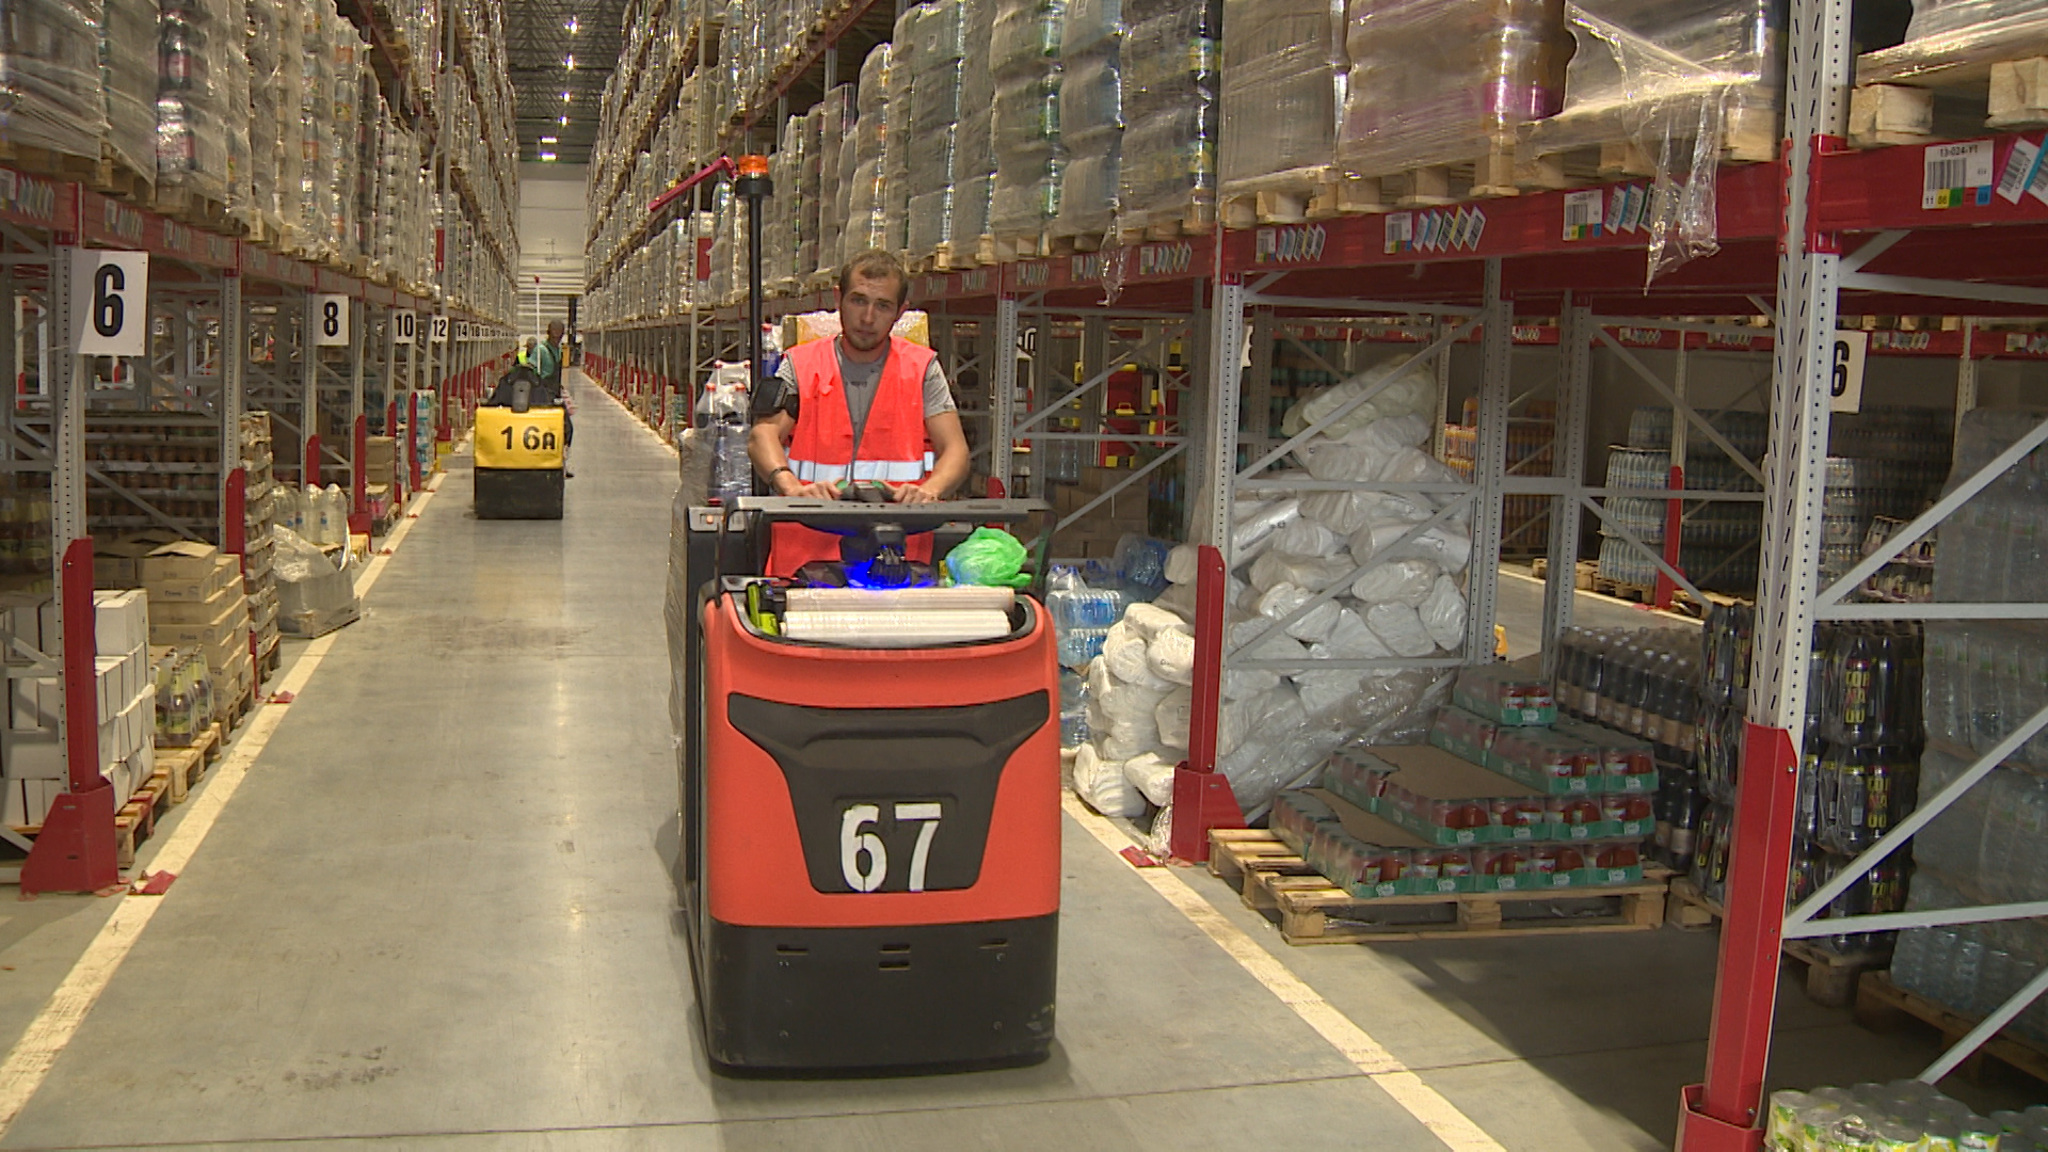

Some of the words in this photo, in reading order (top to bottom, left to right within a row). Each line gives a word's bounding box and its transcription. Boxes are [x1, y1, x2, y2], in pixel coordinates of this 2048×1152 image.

[93, 264, 124, 337] 6
[323, 301, 339, 337] 8
[395, 313, 414, 337] 10
[433, 319, 447, 337] 12
[457, 324, 468, 337] 14
[1831, 340, 1850, 397] 6
[841, 803, 942, 893] 67
